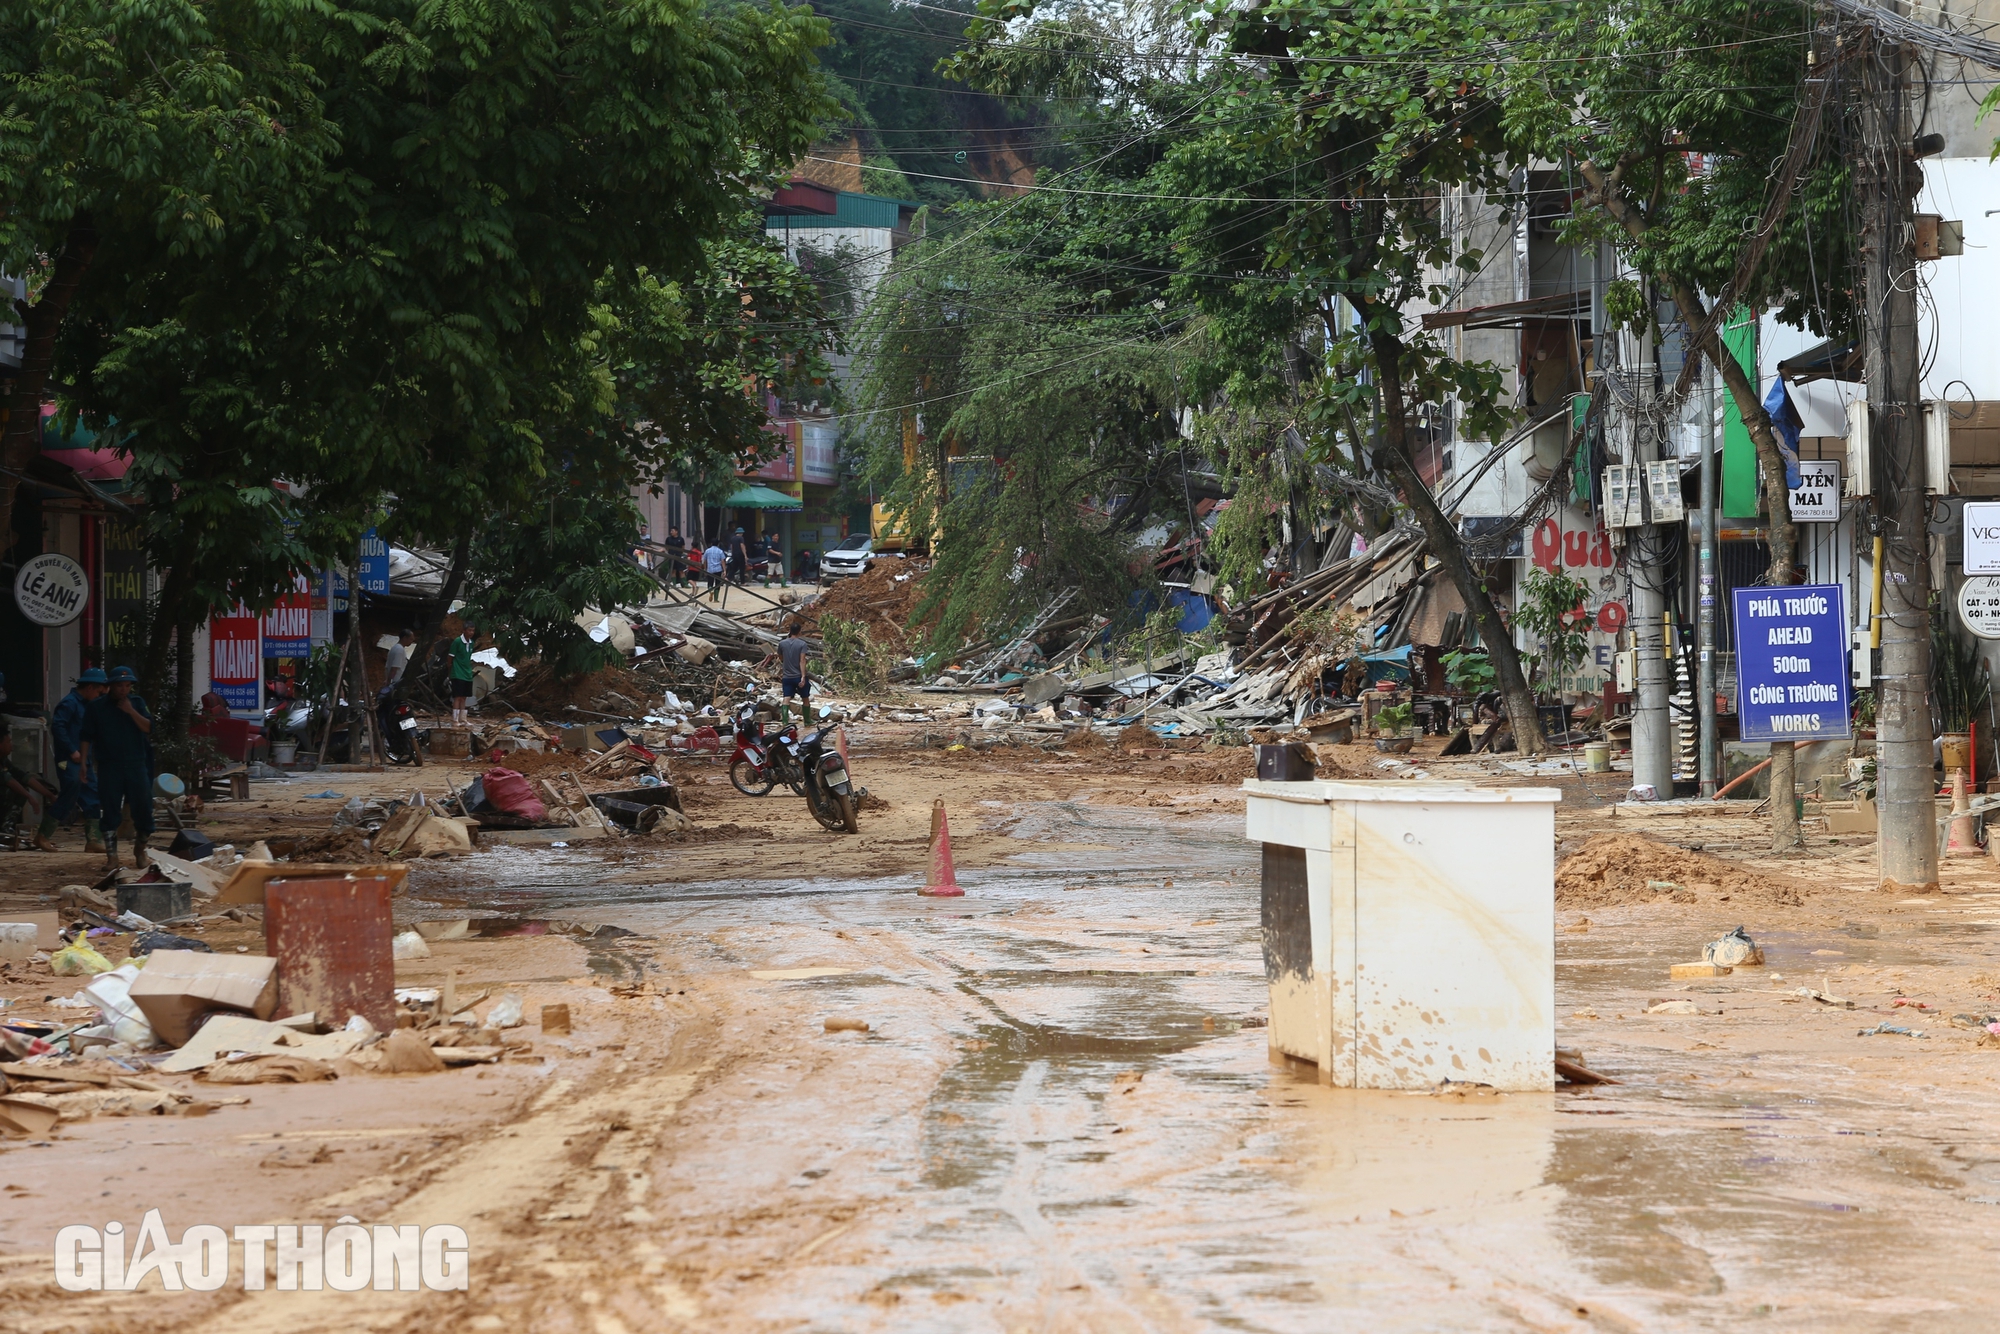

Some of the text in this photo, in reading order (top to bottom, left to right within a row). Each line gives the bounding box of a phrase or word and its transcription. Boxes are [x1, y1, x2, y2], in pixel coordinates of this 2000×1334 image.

[1795, 493, 1823, 506] MAI
[34, 558, 61, 569] CHUYÊN
[70, 571, 82, 587] NAM
[104, 565, 140, 600] THÁI
[22, 572, 80, 611] LÊ ANH
[368, 580, 384, 590] LCD
[1749, 593, 1828, 617] PHÍA TRƯỚC
[266, 602, 308, 636] MÀNH
[1768, 626, 1812, 645] AHEAD
[214, 631, 256, 679] MÀNH
[1773, 656, 1811, 674] 500m
[1576, 674, 1595, 691] như
[1750, 681, 1838, 705] CÔNG TRƯỜNG
[1770, 714, 1821, 733] WORKS
